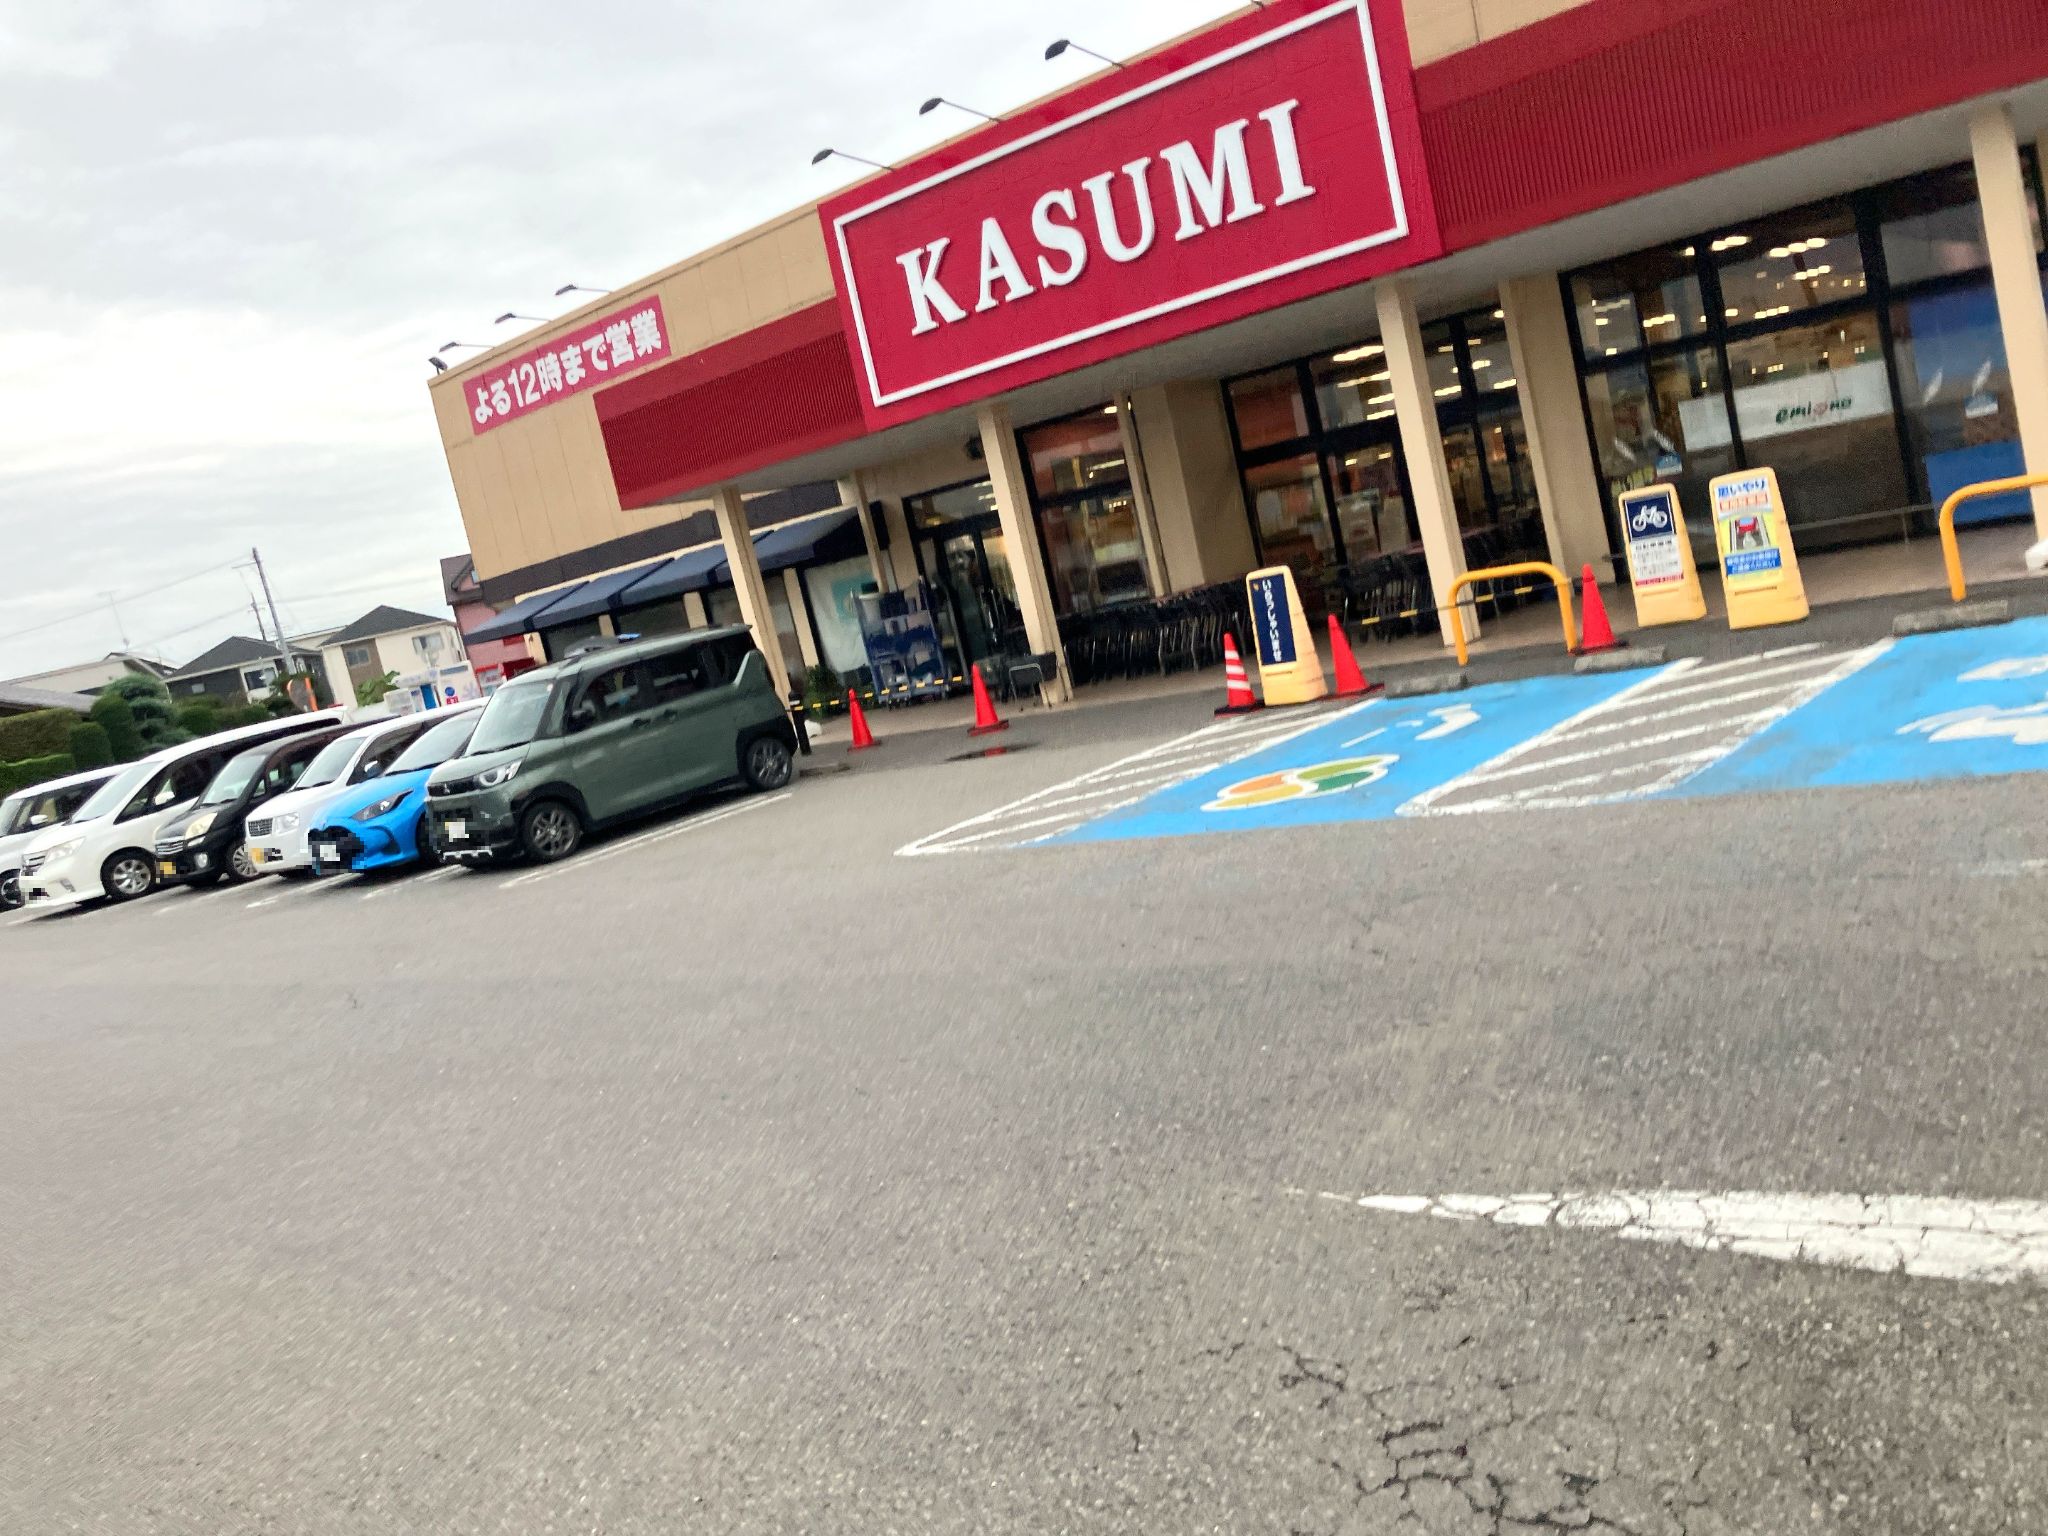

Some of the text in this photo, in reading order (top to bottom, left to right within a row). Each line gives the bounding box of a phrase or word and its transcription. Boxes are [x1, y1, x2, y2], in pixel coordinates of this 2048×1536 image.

[896, 99, 1316, 336] KASUMI
[474, 308, 662, 424] よる12時まで営業
